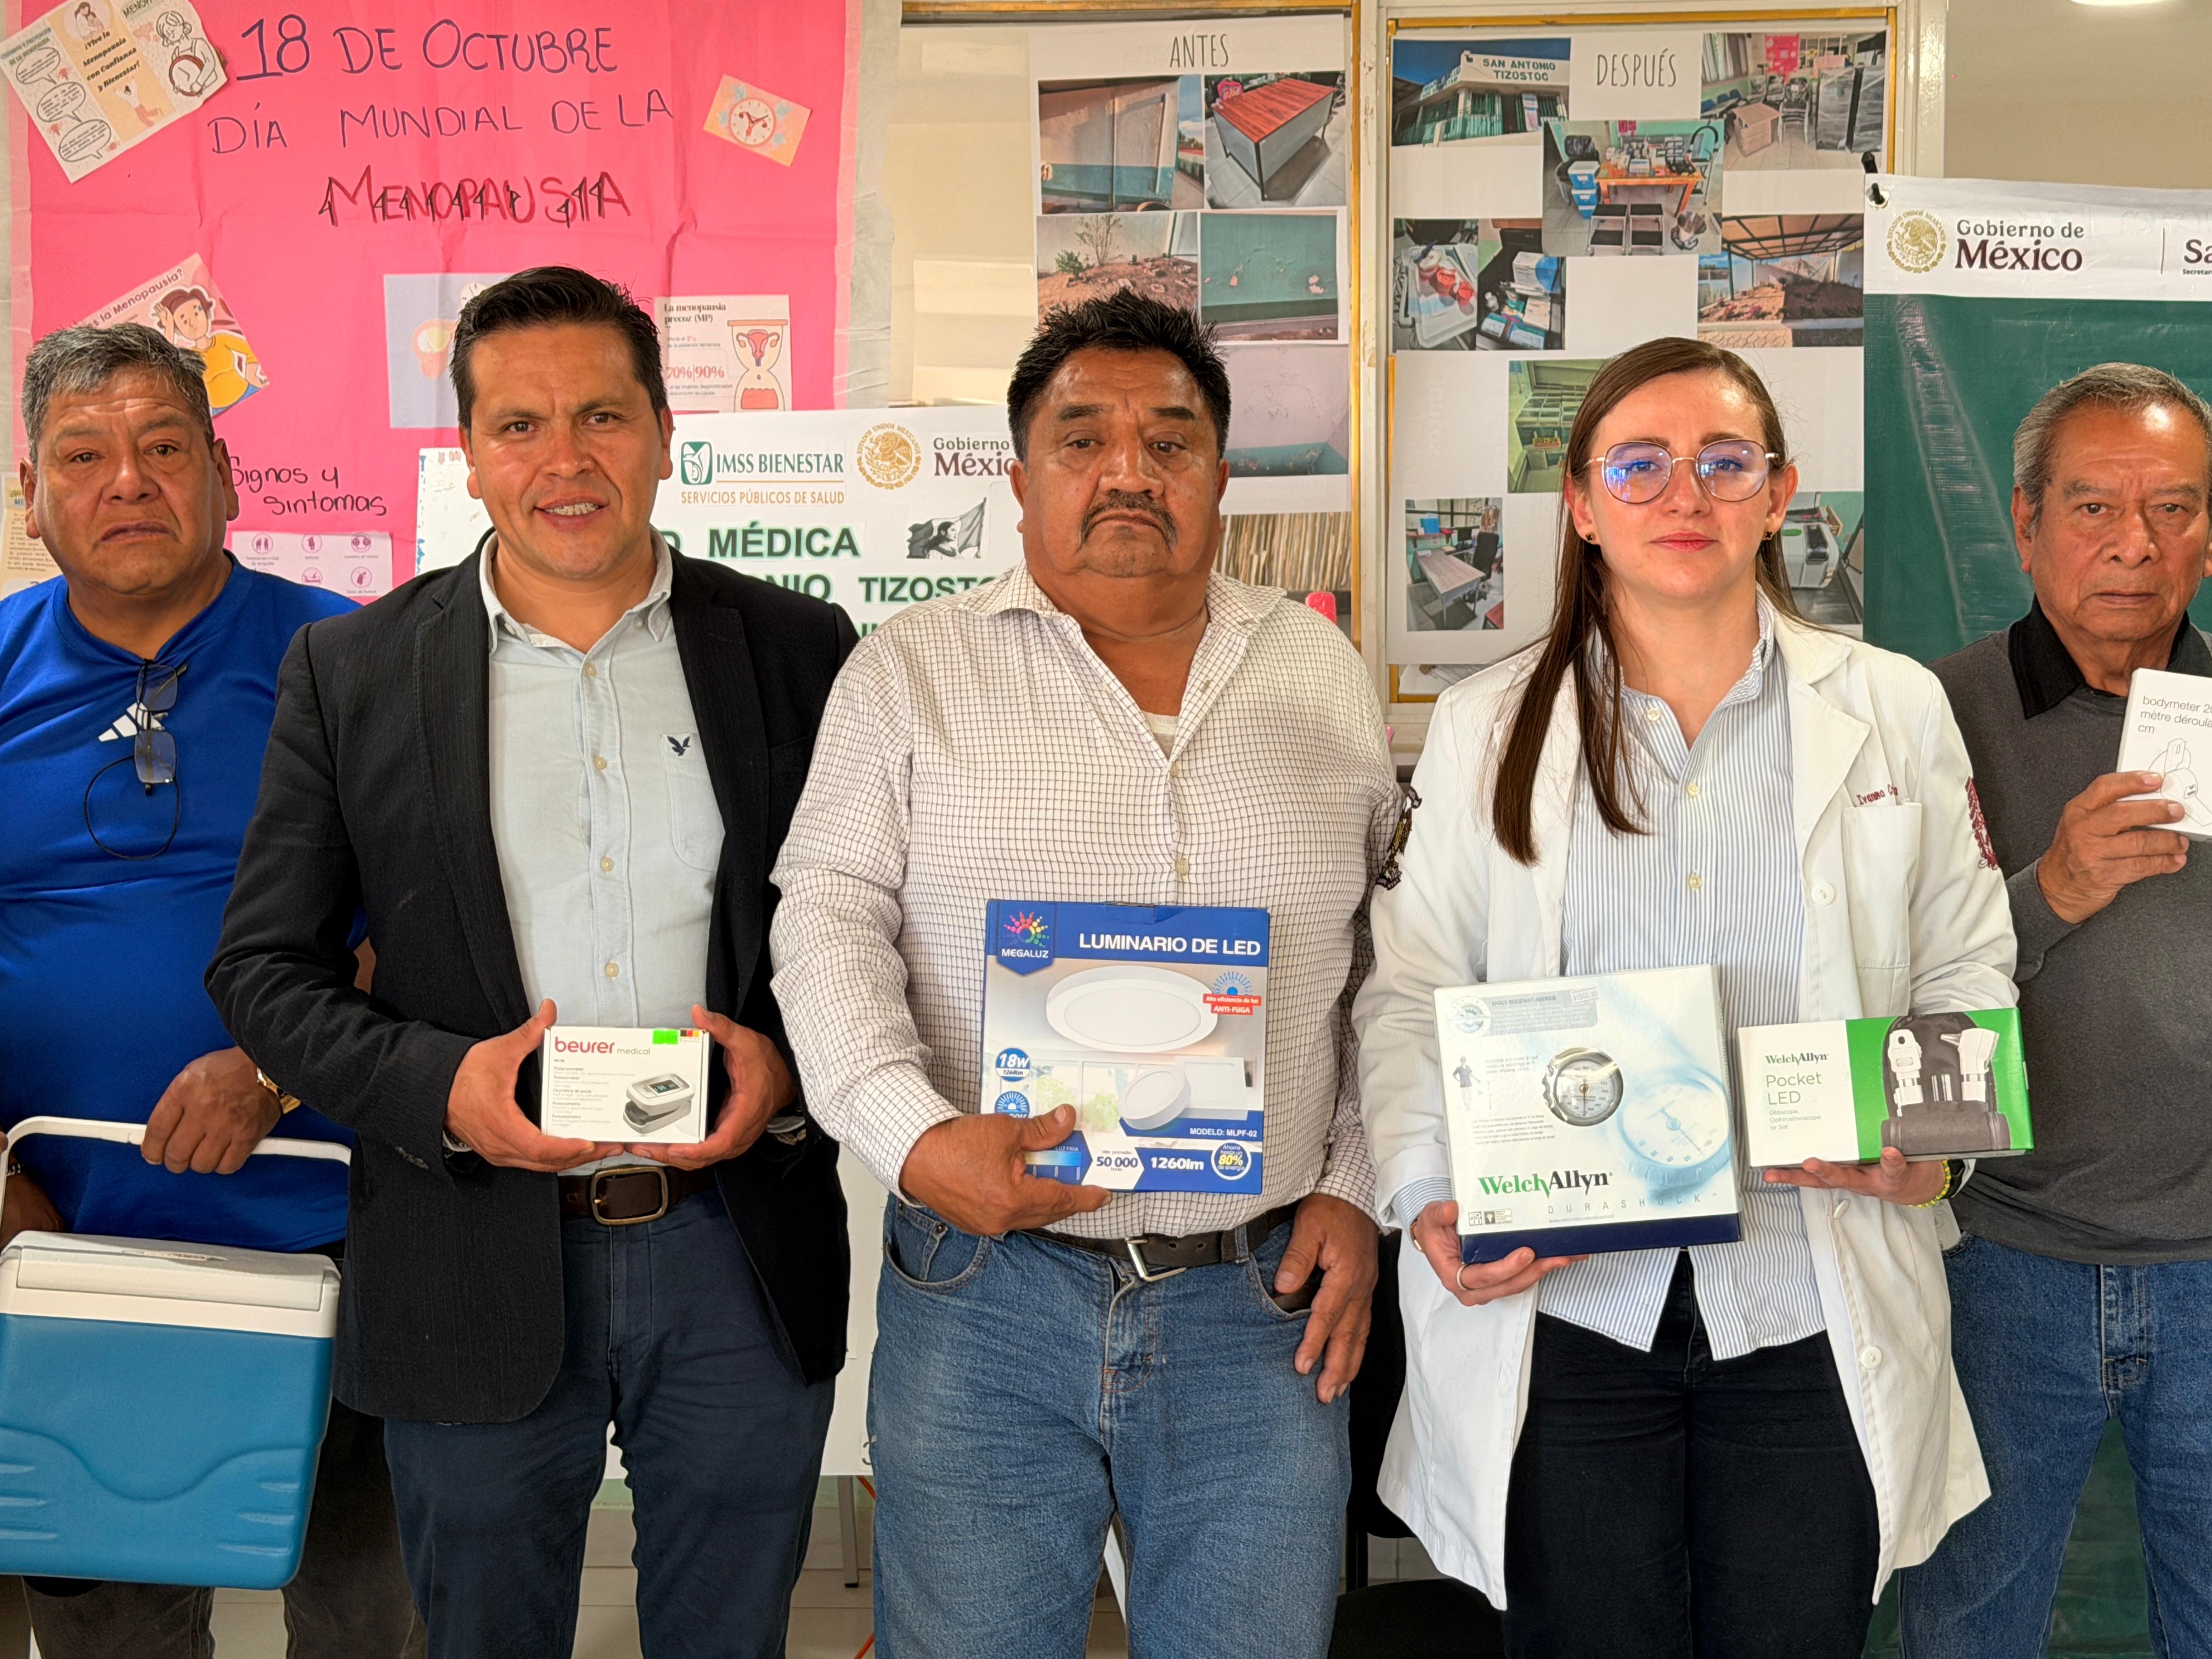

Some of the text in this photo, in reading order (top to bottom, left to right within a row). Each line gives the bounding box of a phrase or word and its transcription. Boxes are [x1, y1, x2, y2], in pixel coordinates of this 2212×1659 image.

[83, 37, 126, 67] Menopausia
[236, 14, 618, 81] 18 DE OCTUBRE
[1170, 33, 1229, 68] ANTES
[1483, 58, 1556, 71] SAN ANTONIO
[1596, 48, 1677, 88] DESPUÉS
[87, 69, 100, 81] con
[1493, 70, 1549, 82] TIZOSTOC
[207, 89, 675, 154] DÍA MUNDIAL DE LA
[318, 165, 631, 228] MENOPAUSIA
[1957, 219, 2084, 239] Gobierno de
[1955, 239, 2083, 272] México
[100, 312, 112, 324] la
[113, 268, 183, 315] Menopausia?
[664, 302, 726, 313] La menopausia
[664, 314, 713, 325] precoz (MP)
[933, 437, 1010, 450] Gobierno
[716, 453, 844, 473] IMSS BIENESTAR
[322, 466, 338, 489] y
[681, 488, 844, 504] SERVICIOS PÚBLICOS DE SALUD
[709, 521, 859, 558] MÉDICA
[2142, 695, 2201, 712] bodymeter
[2140, 710, 2171, 722] mètre
[2137, 724, 2155, 734] cm
[1079, 934, 1261, 955] LUMINARIO DE LED
[1001, 949, 1048, 958] MEGALUZ
[555, 1036, 650, 1055] beurer medical
[1766, 1071, 1822, 1088] Pocket
[1768, 1091, 1801, 1105] LED
[1189, 1127, 1257, 1137] MODELO: MLPF-02
[1097, 1156, 1138, 1167] 50 000
[1151, 1157, 1204, 1170] 1260lm
[1218, 1155, 1243, 1166] 80%
